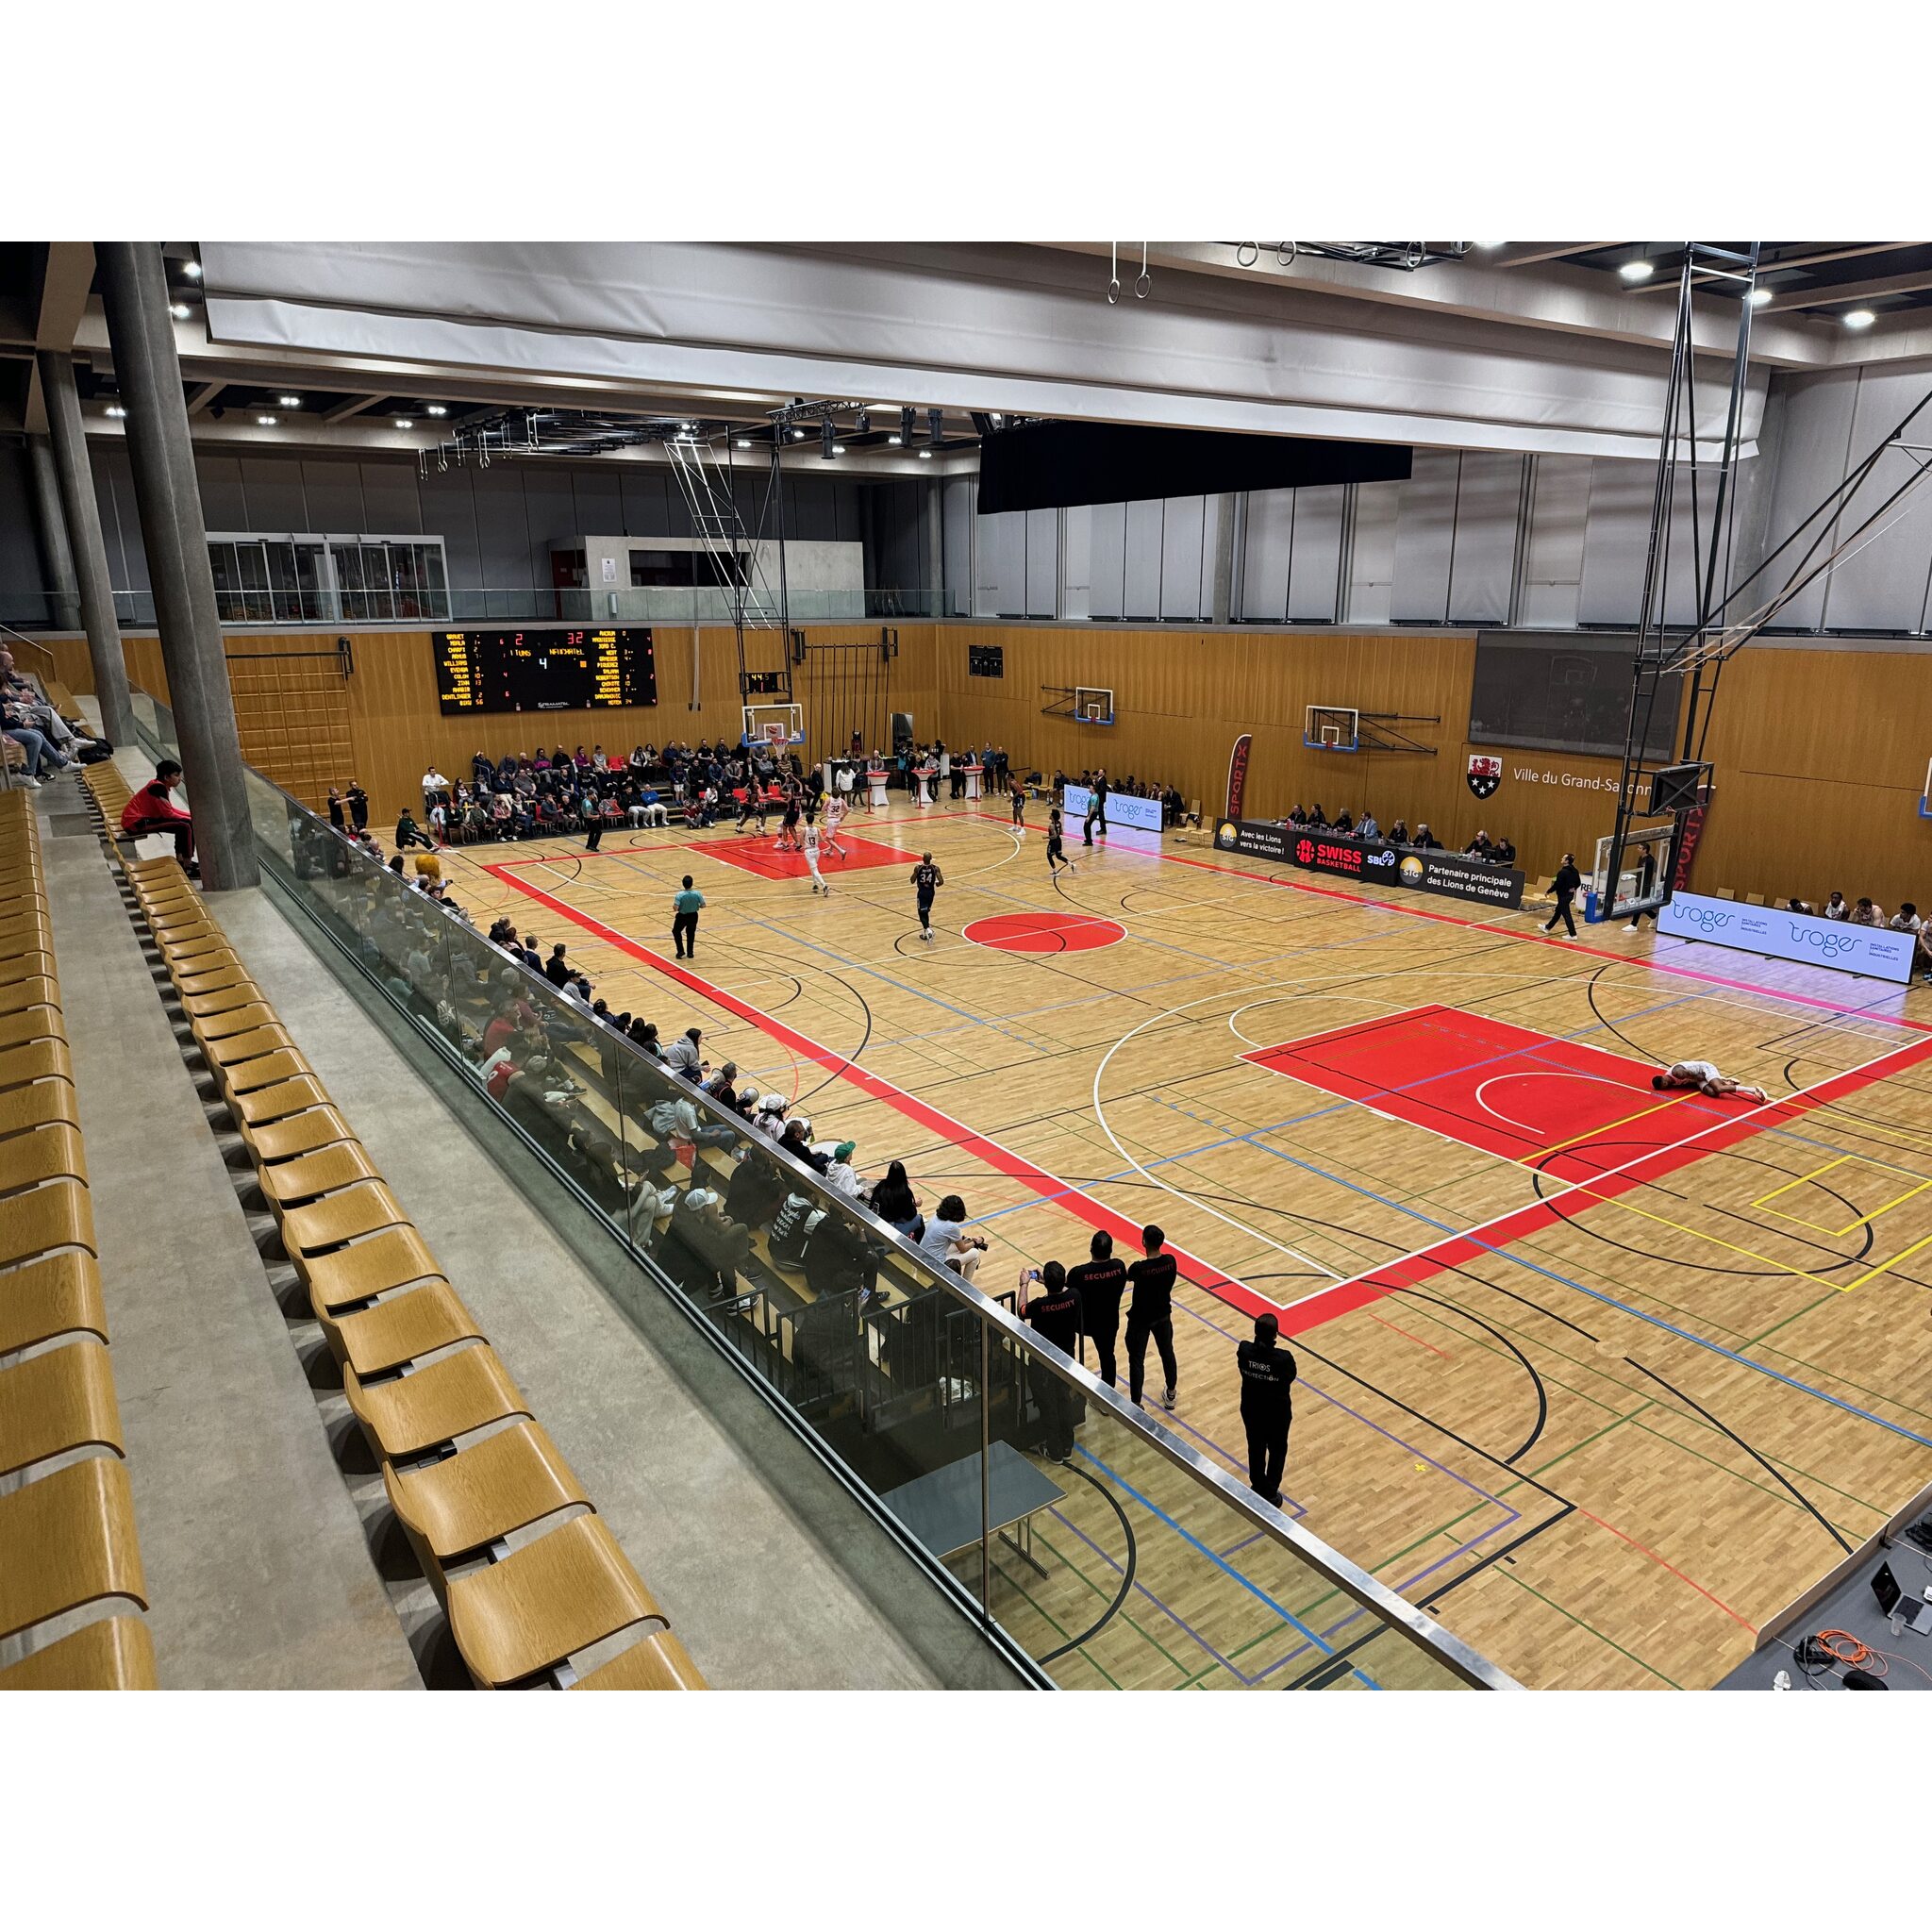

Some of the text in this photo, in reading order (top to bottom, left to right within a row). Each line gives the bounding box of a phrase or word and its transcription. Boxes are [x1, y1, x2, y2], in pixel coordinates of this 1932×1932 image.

[516, 634, 523, 645] 2
[567, 632, 583, 644] 32
[539, 658, 547, 669] 4
[1513, 768, 1539, 782] Ville
[1542, 771, 1557, 785] du
[808, 837, 816, 845] 13
[1241, 830, 1255, 839] Avec
[1265, 834, 1281, 844] Lions
[1317, 844, 1362, 864] SWISS
[1317, 858, 1361, 872] BASKETBALL
[1367, 855, 1385, 866] SBL
[920, 873, 932, 883] 34
[1403, 869, 1419, 878] SIG
[1429, 864, 1512, 887] Partenaire principale
[1427, 876, 1509, 899] des Lions de Genève
[1672, 899, 1735, 932] troger
[1789, 921, 1862, 958] troger
[1084, 1269, 1121, 1280] SECURITY
[1041, 1299, 1075, 1312] SECURITY
[1249, 1361, 1270, 1372] TRIOS
